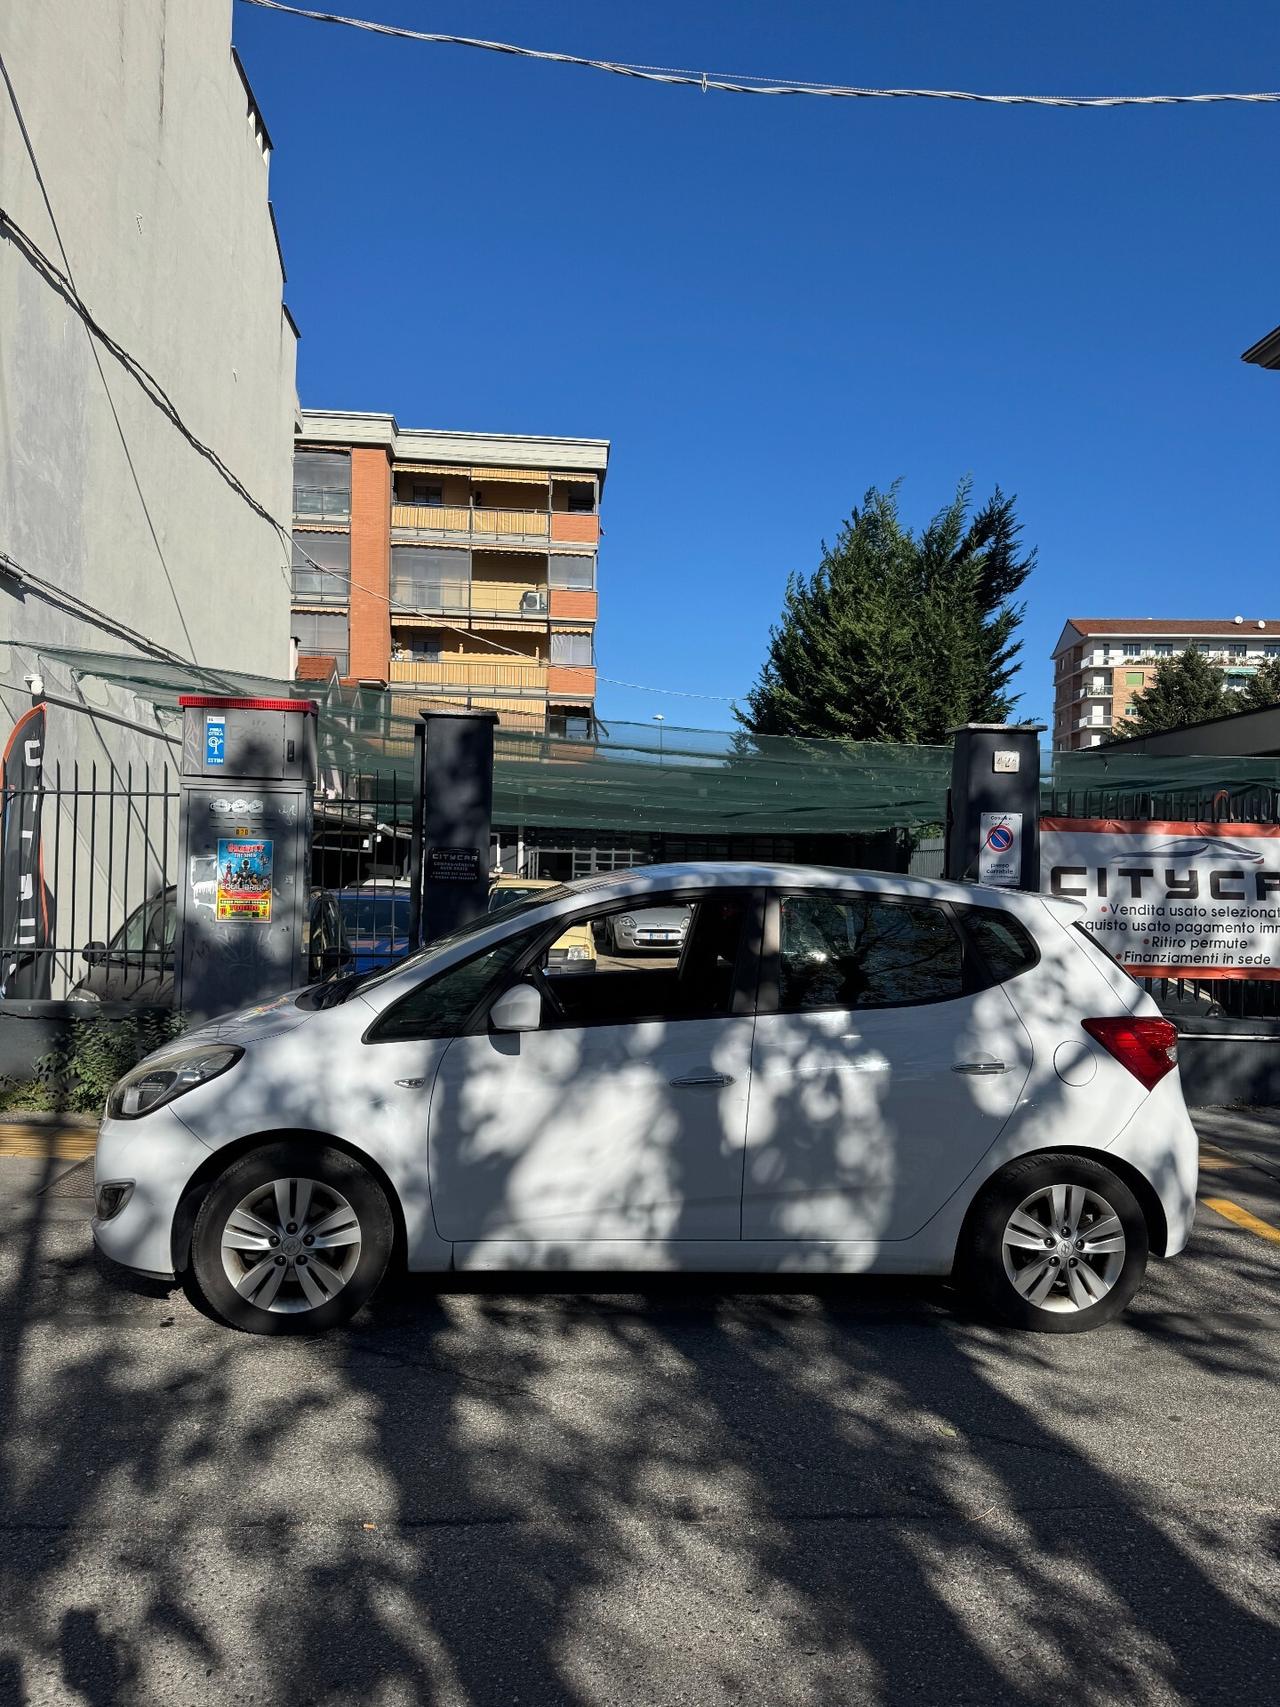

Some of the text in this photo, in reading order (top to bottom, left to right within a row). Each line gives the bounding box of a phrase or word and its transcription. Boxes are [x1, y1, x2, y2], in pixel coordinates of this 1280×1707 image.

[1110, 903, 1165, 916] Vendita
[1169, 905, 1207, 917] usato
[1132, 920, 1170, 932] usato
[1175, 922, 1255, 935] pagamento
[1151, 936, 1248, 950] Ritiro permute
[1124, 951, 1271, 965] Finanziamenti in sede
